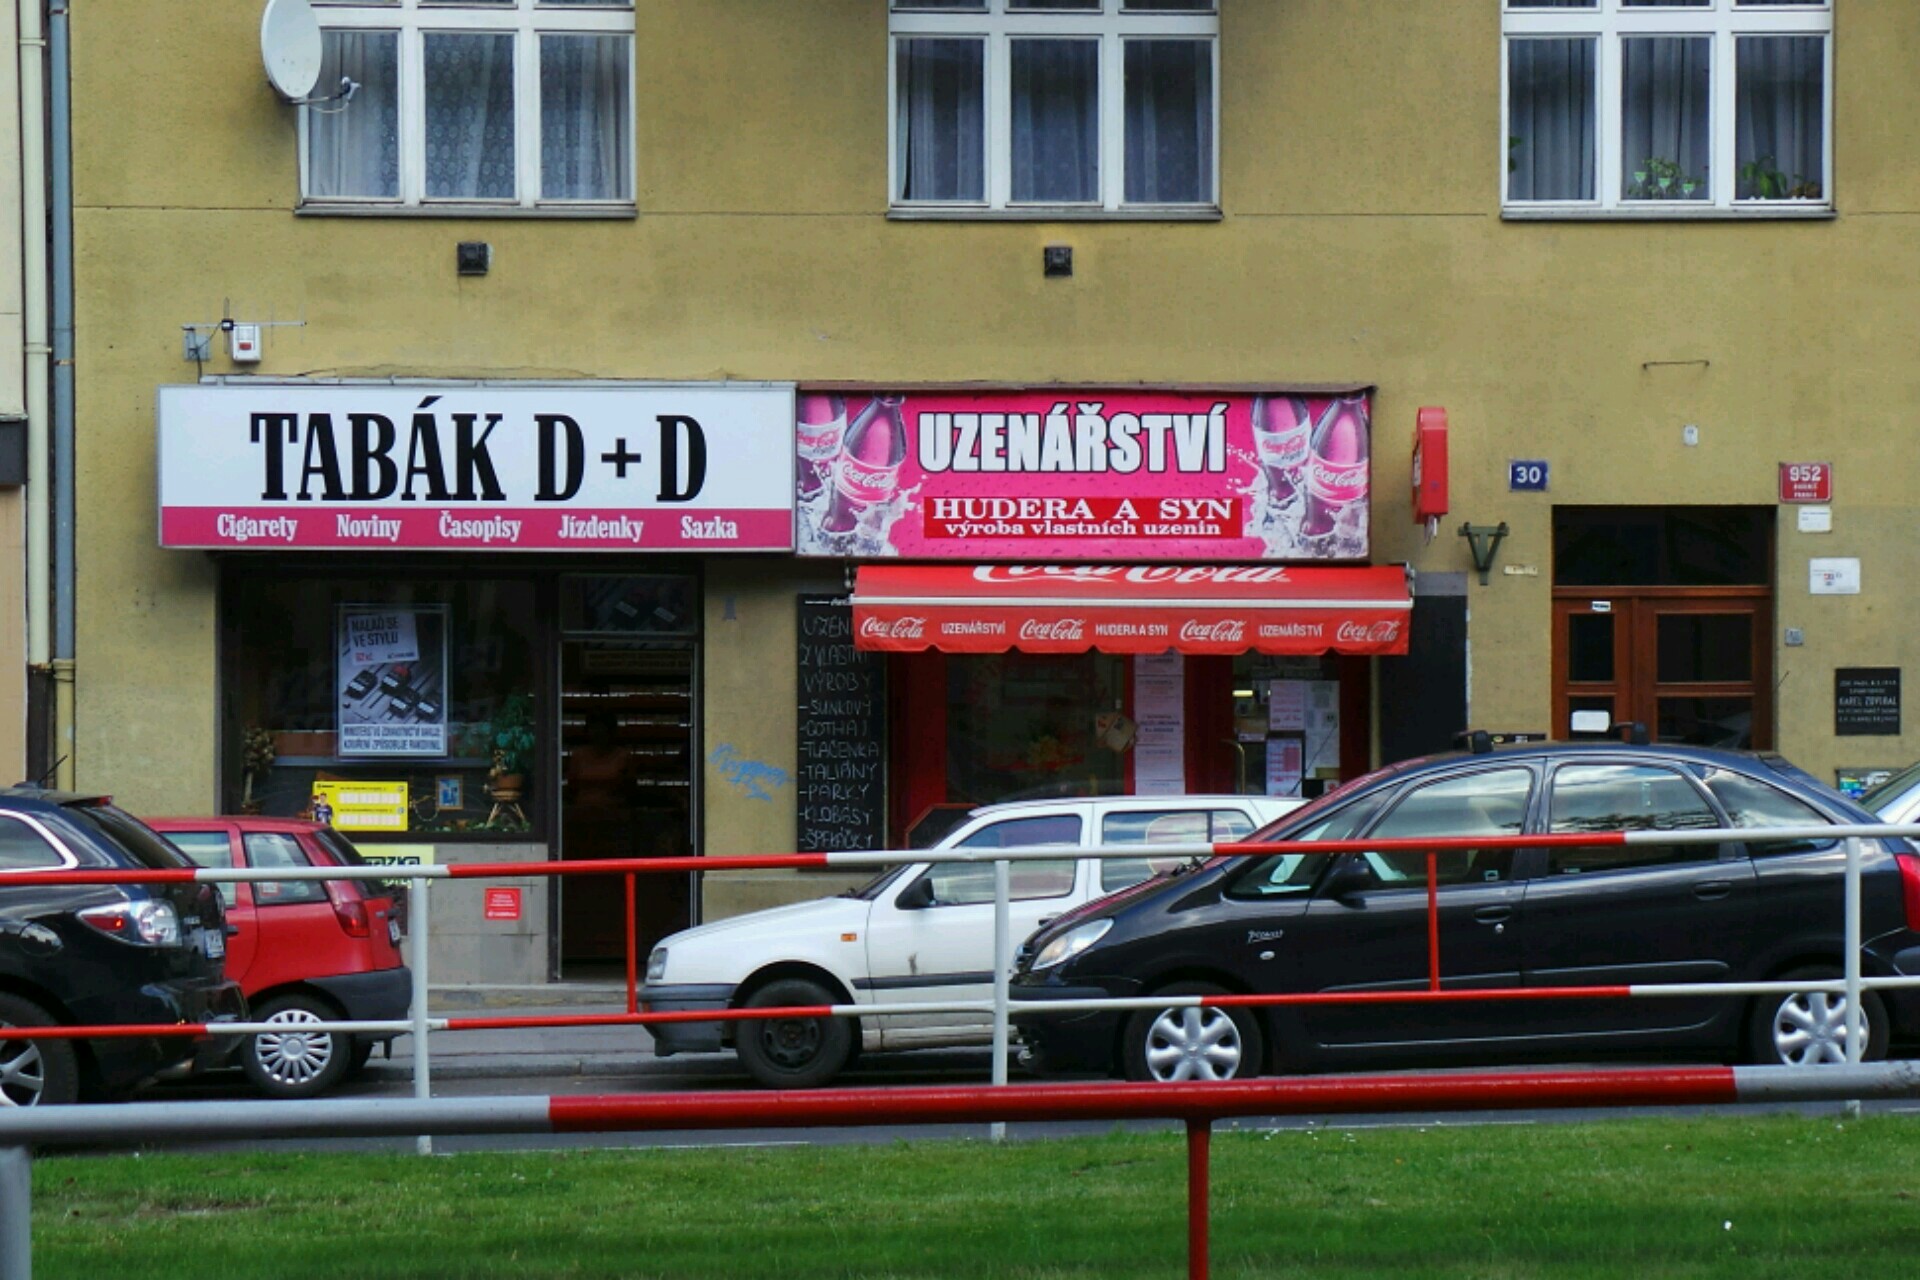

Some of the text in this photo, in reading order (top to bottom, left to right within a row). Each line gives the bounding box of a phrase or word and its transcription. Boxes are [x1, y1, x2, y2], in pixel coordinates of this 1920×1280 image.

[918, 402, 1228, 473] UZENÁŘSTVÍ
[250, 395, 506, 502] TABÁK
[1516, 466, 1541, 484] 30
[1790, 466, 1822, 482] 952
[932, 498, 1233, 520] HUDERA A SYN
[217, 510, 738, 543] Cigarety Noviny Časopisy Jízdenky Sazka
[945, 519, 1221, 537] výroba vlastních uzenin
[941, 620, 1006, 635] UZENÁŘSTVÍ
[1095, 624, 1137, 636] HUDERA
[1139, 624, 1146, 636] A
[1147, 624, 1169, 636] SYN
[1259, 622, 1323, 637] UZENÁŘSTVÍ
